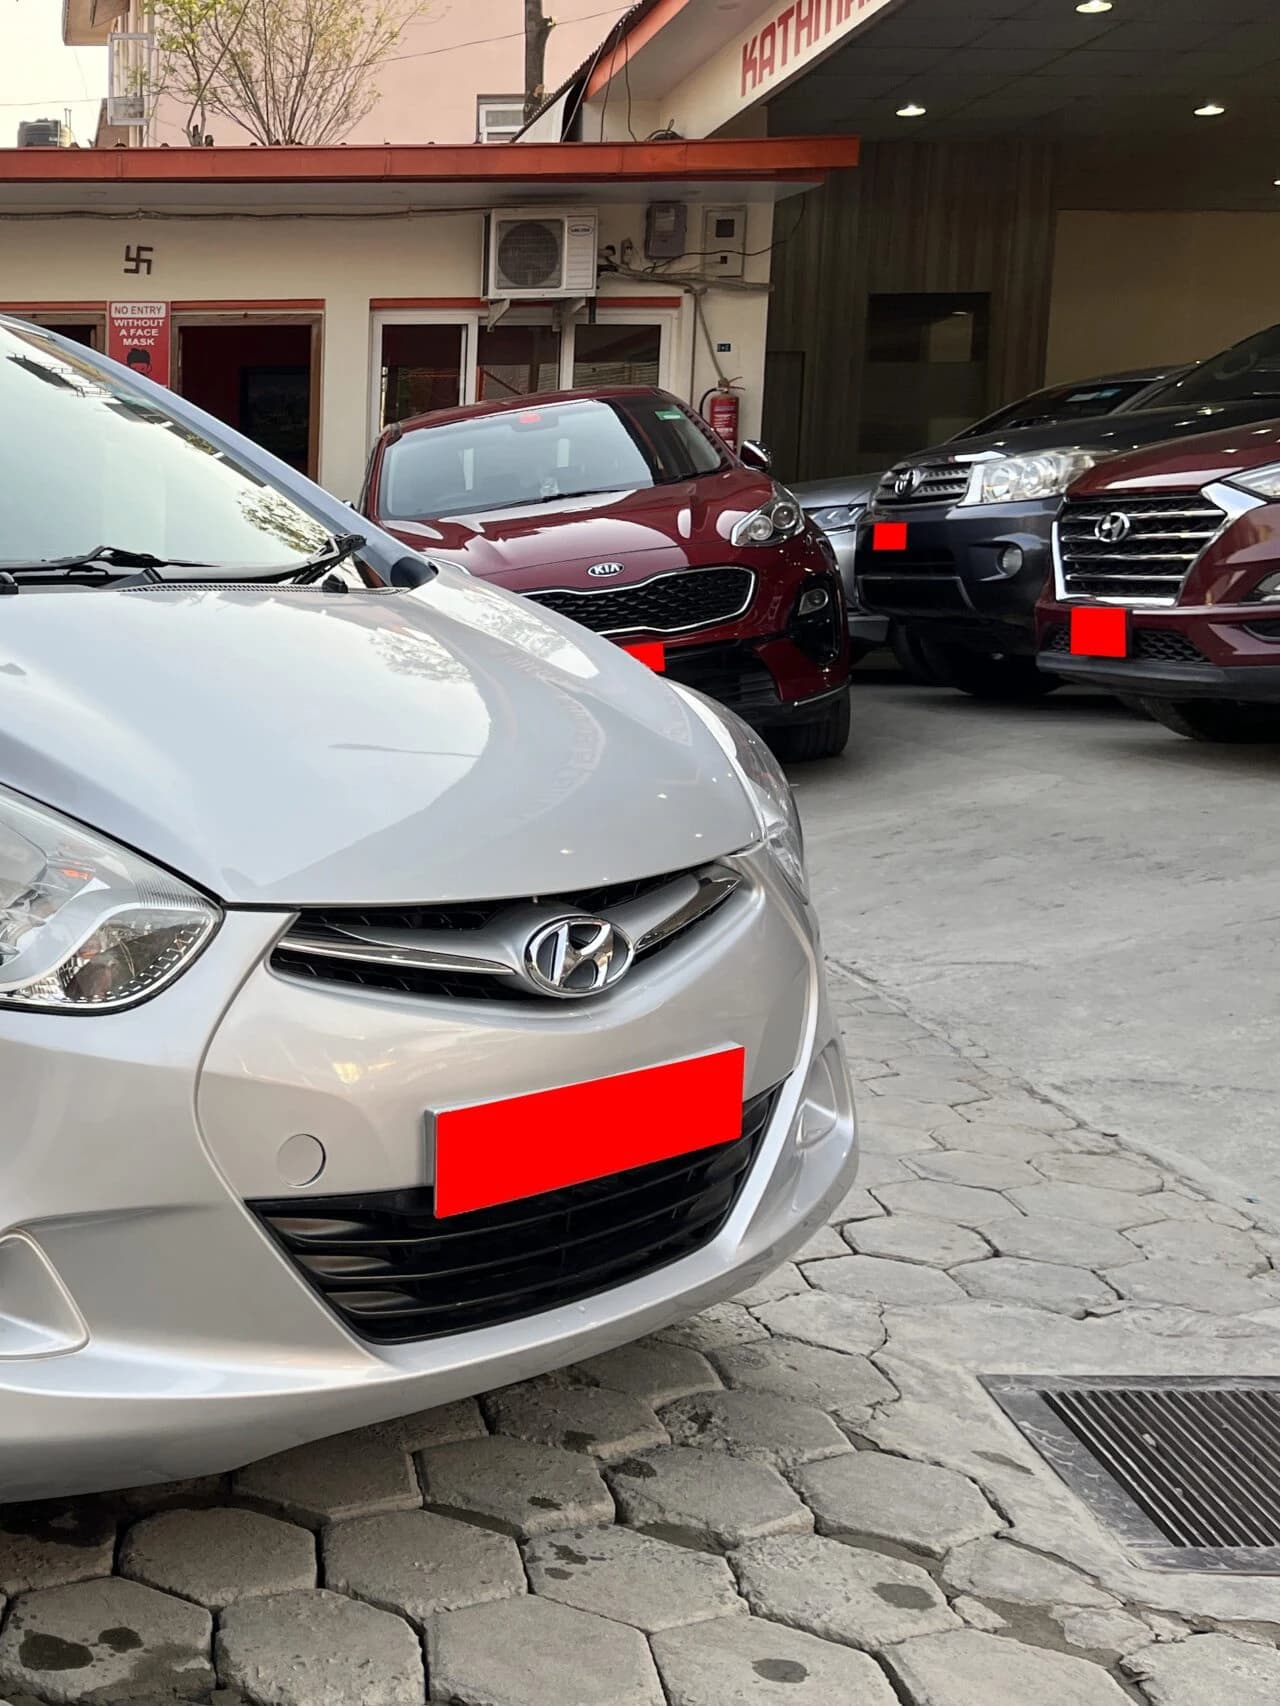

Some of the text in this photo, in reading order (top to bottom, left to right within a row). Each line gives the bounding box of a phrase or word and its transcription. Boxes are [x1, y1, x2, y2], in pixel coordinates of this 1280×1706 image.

[114, 305, 162, 315] NO ENTRY
[114, 319, 164, 327] WITHOUT
[119, 328, 160, 336] A FACE
[122, 338, 155, 346] MASK
[593, 564, 621, 575] KIA
